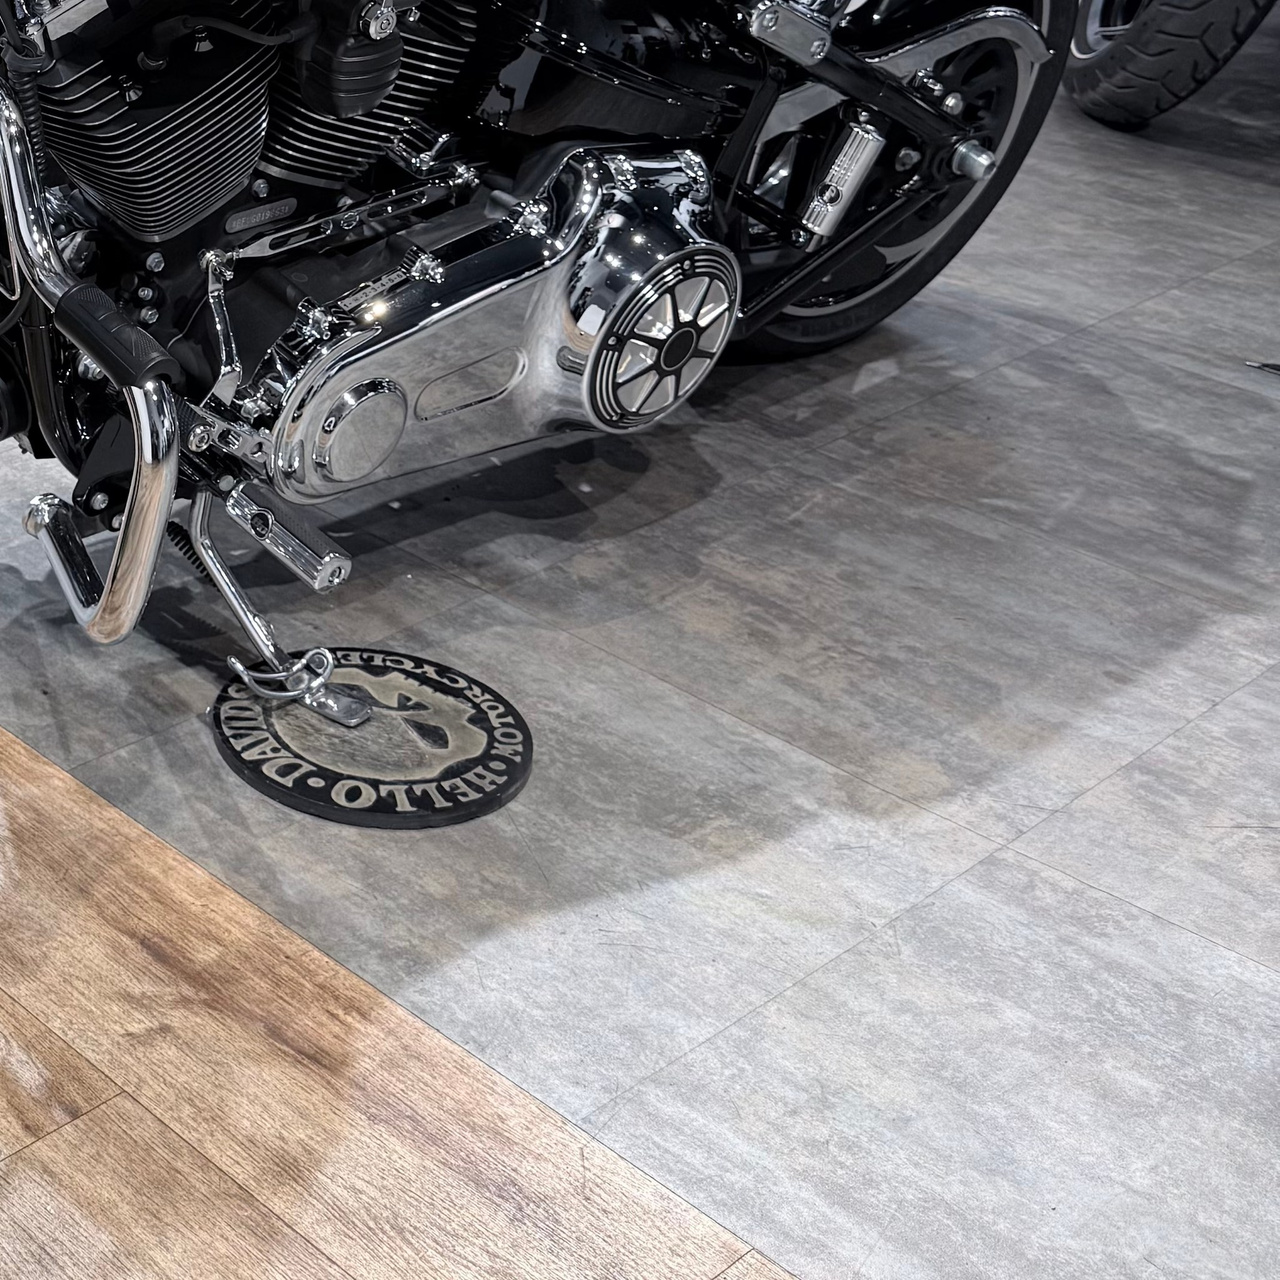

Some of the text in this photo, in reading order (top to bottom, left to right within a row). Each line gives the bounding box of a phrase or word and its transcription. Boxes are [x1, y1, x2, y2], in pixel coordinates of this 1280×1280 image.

[220, 682, 509, 812] HELLO DAVIDS
[333, 650, 525, 763] MOTORCYCLE
